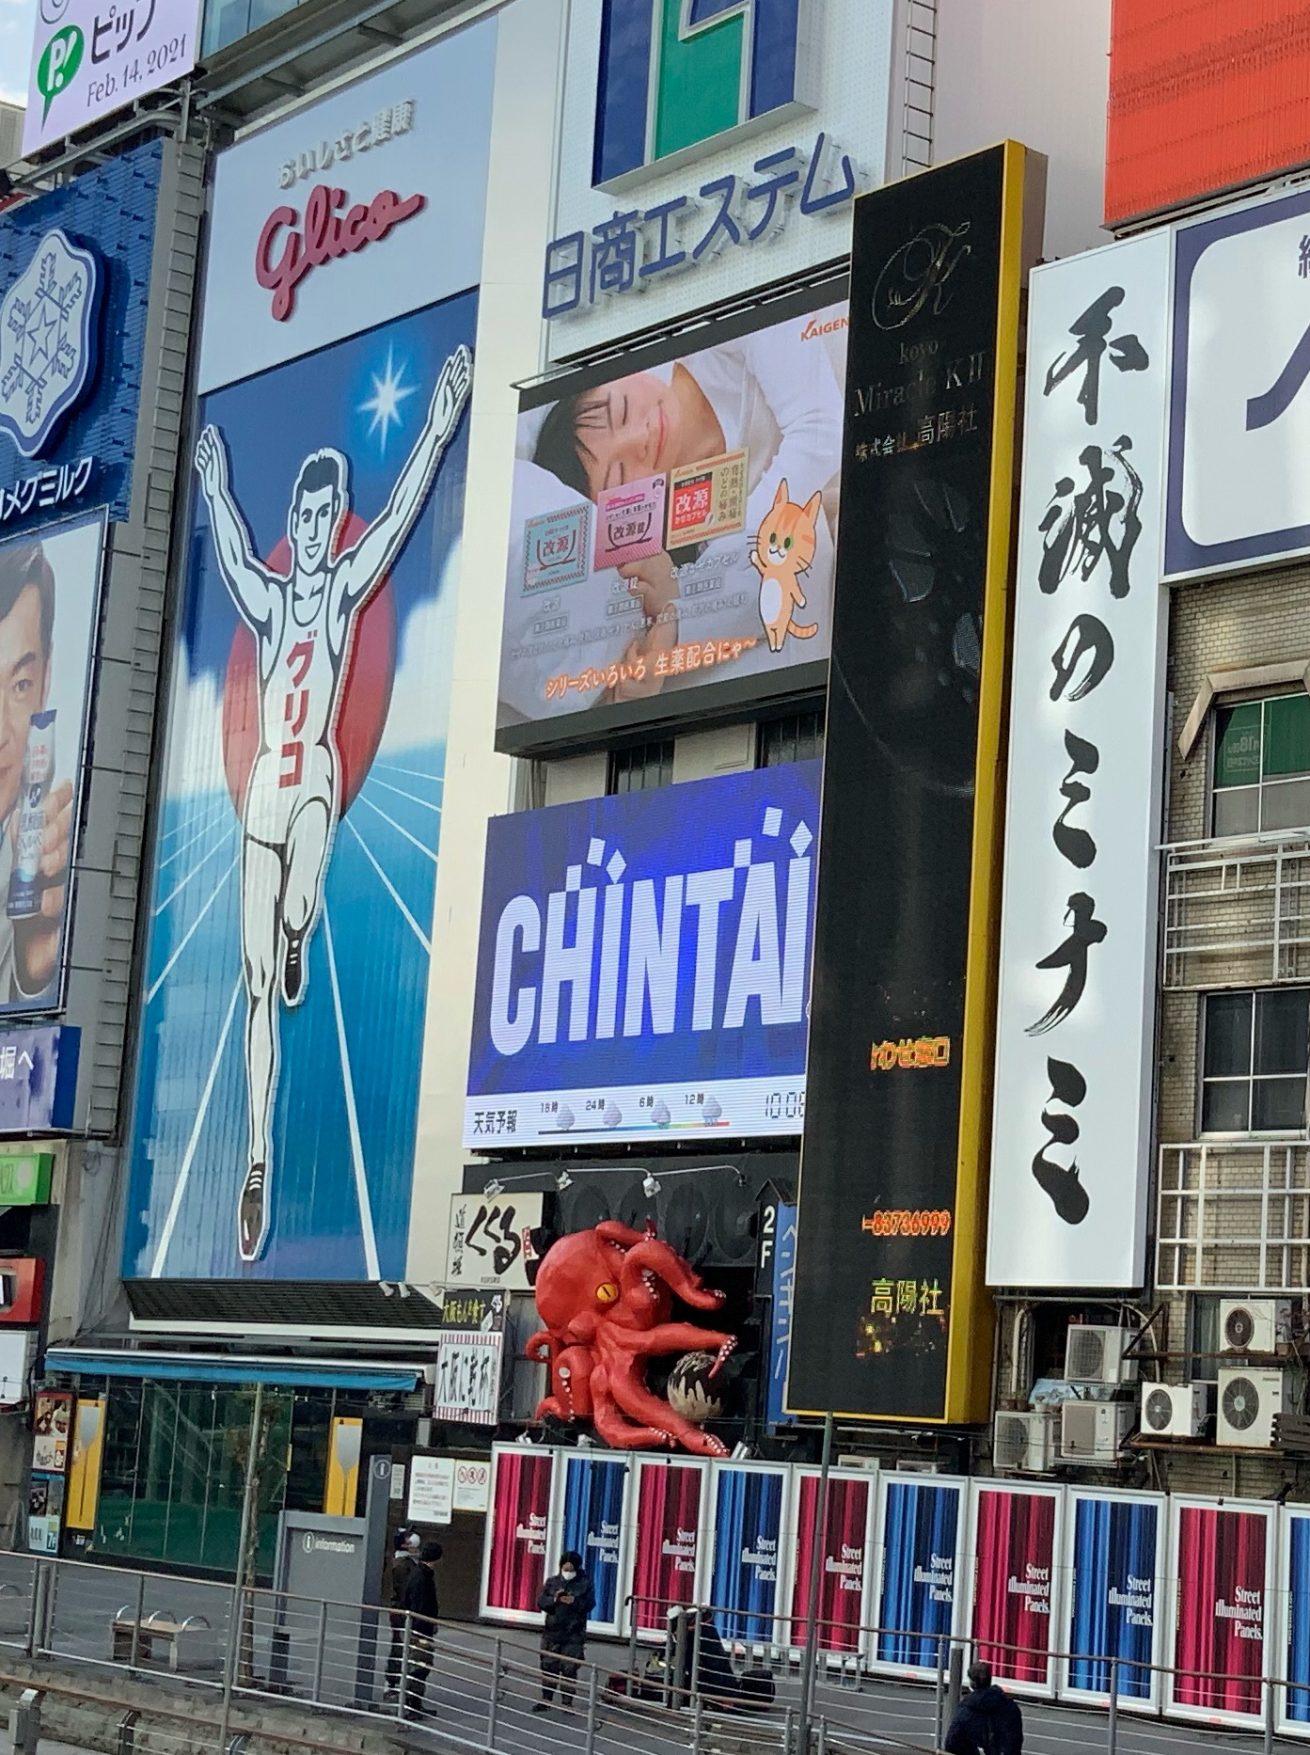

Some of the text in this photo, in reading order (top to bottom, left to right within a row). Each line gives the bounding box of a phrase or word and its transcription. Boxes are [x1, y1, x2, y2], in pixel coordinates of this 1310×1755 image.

[87, 73, 118, 107] Feb.
[147, 34, 186, 73] 2021
[278, 99, 414, 189] おいしさと健康
[542, 132, 855, 319] 日商エステム
[256, 185, 426, 322] Glico
[800, 319, 848, 341] KAIGEN
[545, 659, 647, 698] シリーズいろいろ
[279, 629, 318, 788] グリコ
[490, 806, 813, 1056] CHINTAI
[473, 1110, 517, 1135] 天気予報
[464, 1205, 521, 1275] くくる
[761, 1205, 775, 1268] 2F
[871, 1278, 945, 1316] 高陽社
[841, 1543, 862, 1560] Street
[931, 1553, 952, 1570] Street
[1025, 1563, 1049, 1581] Street
[1126, 1574, 1151, 1592] Street
[1234, 1586, 1260, 1604] Street
